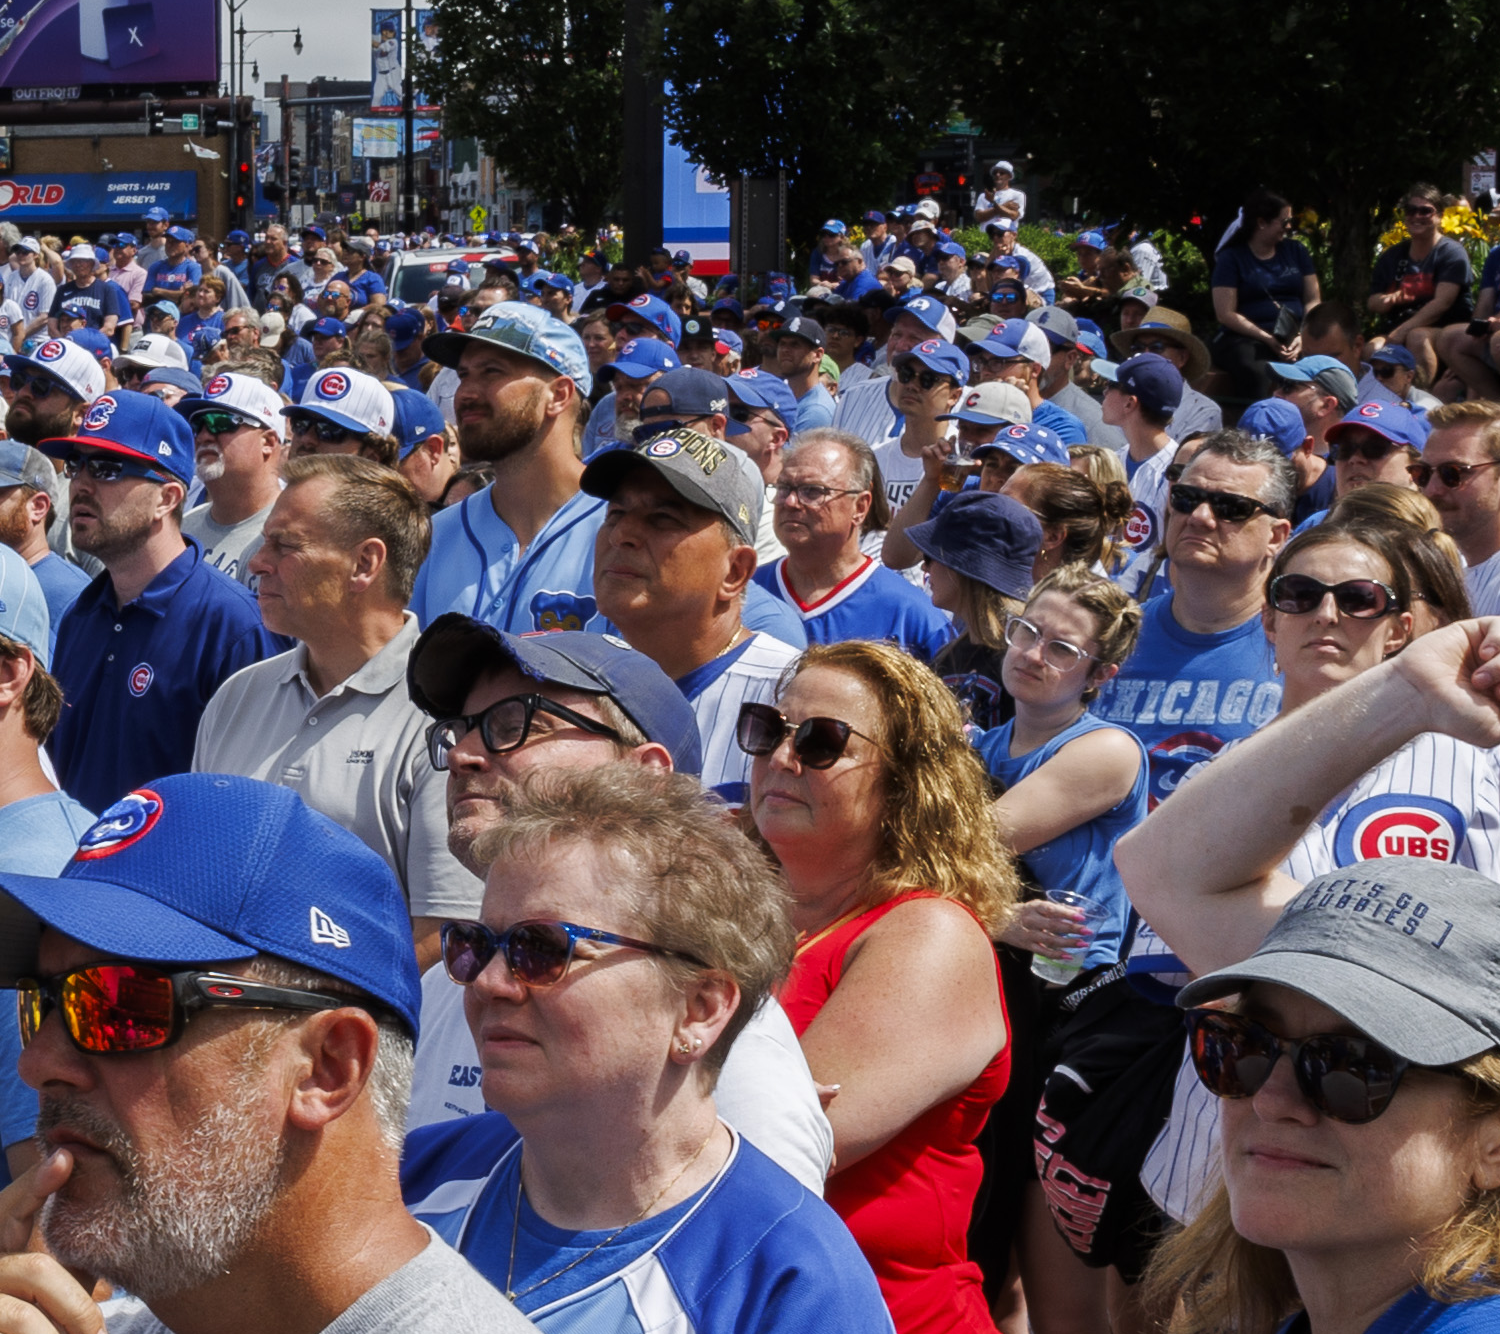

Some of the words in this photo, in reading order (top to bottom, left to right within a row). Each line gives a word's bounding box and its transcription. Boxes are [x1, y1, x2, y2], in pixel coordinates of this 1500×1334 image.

[107, 183, 140, 192] SHIRTS
[147, 182, 171, 191] HATS
[113, 195, 156, 205] JERSEYS
[920, 338, 941, 354] C
[965, 392, 981, 408] C
[1359, 402, 1383, 419] C
[1007, 423, 1030, 439] C
[1123, 507, 1150, 545] CUBS
[1360, 812, 1450, 864] CUBS
[1303, 890, 1421, 936] CUBBIES
[1395, 891, 1430, 921] GO
